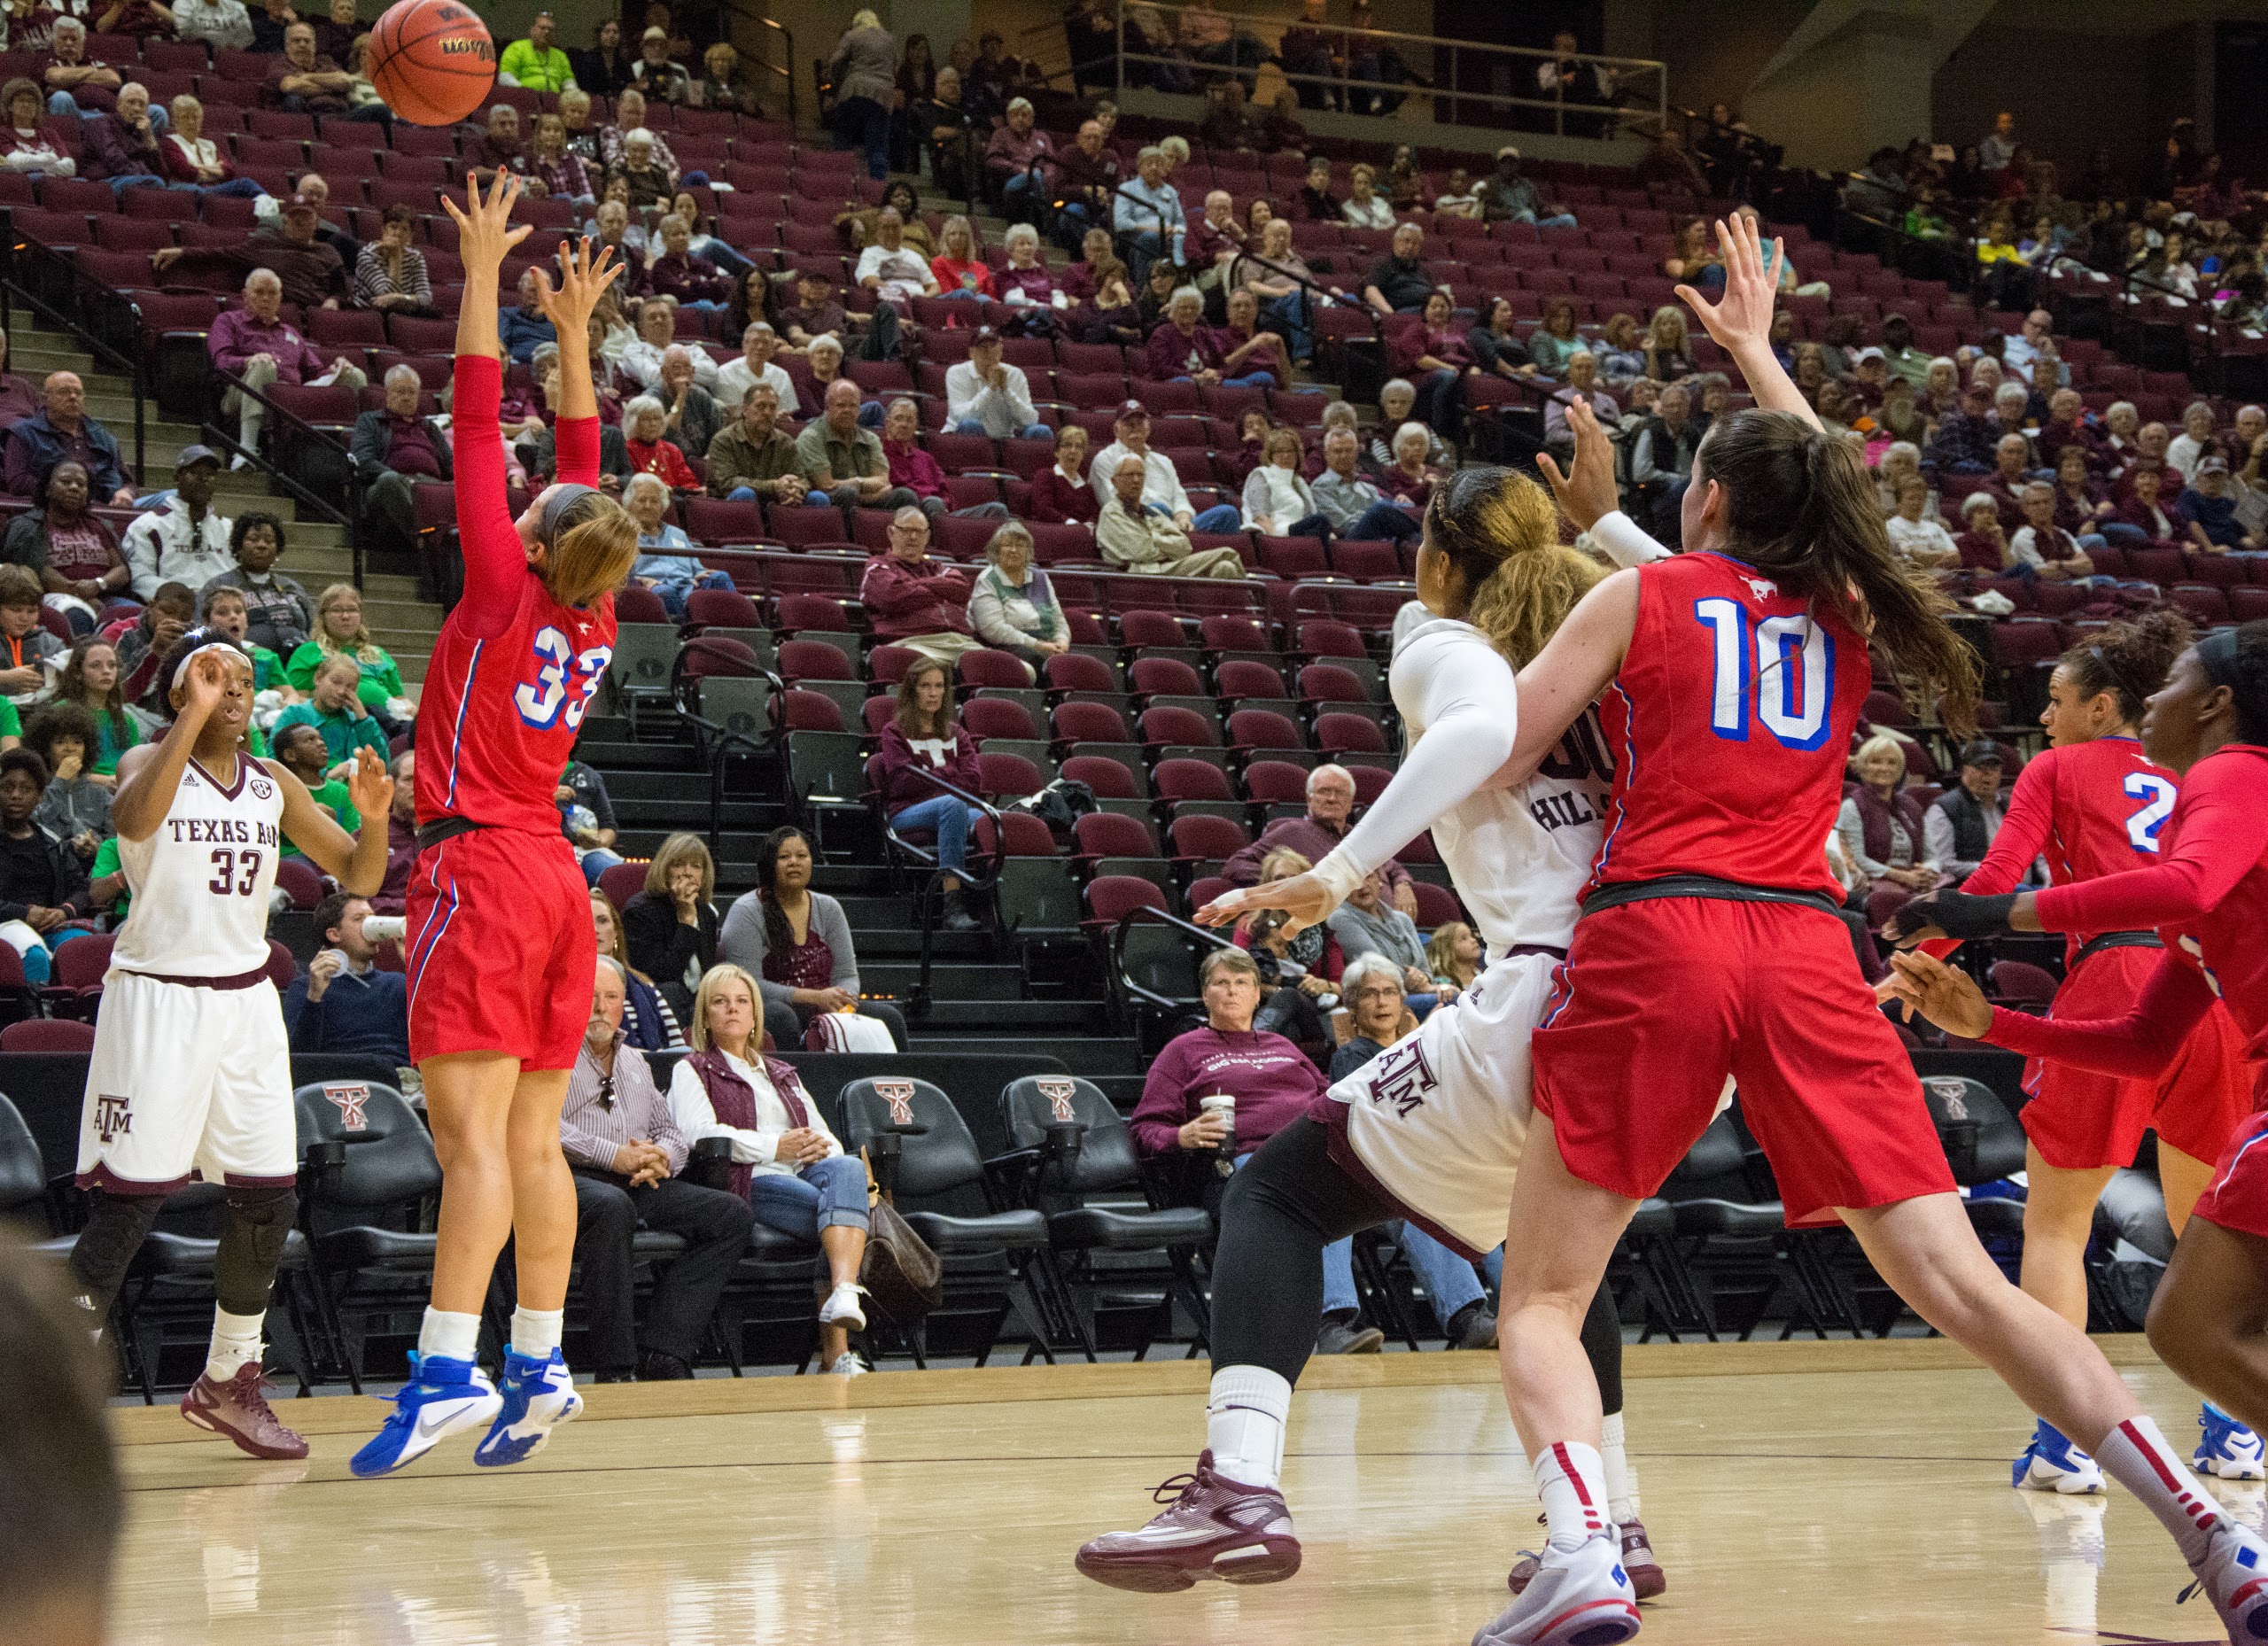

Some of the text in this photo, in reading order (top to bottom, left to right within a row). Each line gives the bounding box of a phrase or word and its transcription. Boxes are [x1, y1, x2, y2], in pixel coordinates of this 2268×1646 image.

[513, 625, 612, 732] 33
[1693, 595, 1837, 752] 10
[252, 780, 270, 797] SEC
[2124, 771, 2179, 855] 2
[168, 819, 250, 843] TEXAS
[209, 848, 263, 897] 33
